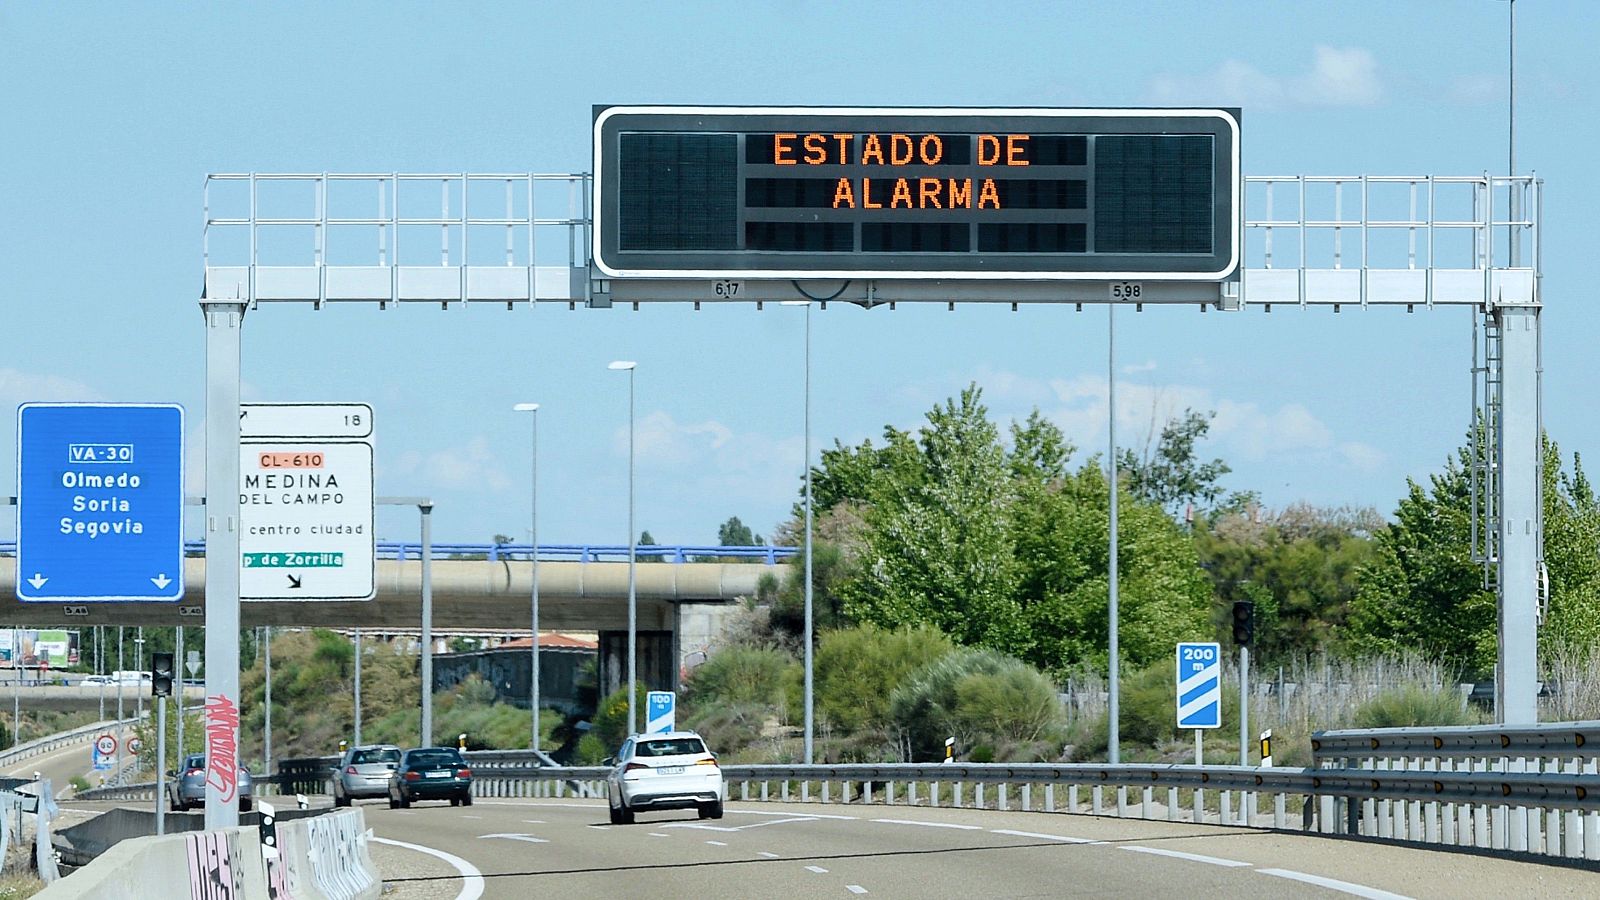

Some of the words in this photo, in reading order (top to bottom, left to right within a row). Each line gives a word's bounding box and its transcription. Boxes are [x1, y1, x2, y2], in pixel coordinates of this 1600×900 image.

[774, 133, 943, 166] ESTADO
[977, 134, 1030, 166] DE
[833, 177, 1000, 209] ALARMA
[344, 414, 361, 426] 18
[72, 446, 131, 461] VA-30
[261, 454, 322, 467] CL-610
[62, 471, 141, 488] Olmedo
[245, 474, 338, 489] MEDINA
[72, 495, 130, 512] Soria
[239, 493, 273, 505] DEL
[282, 493, 344, 505] CAMPO
[60, 517, 144, 539] Segovia
[249, 524, 301, 535] centro
[310, 523, 363, 534] ciudad
[261, 554, 279, 565] de
[284, 553, 343, 565] Zorrilla
[1183, 648, 1214, 660] 200
[1192, 662, 1205, 671] m
[651, 694, 670, 704] 100
